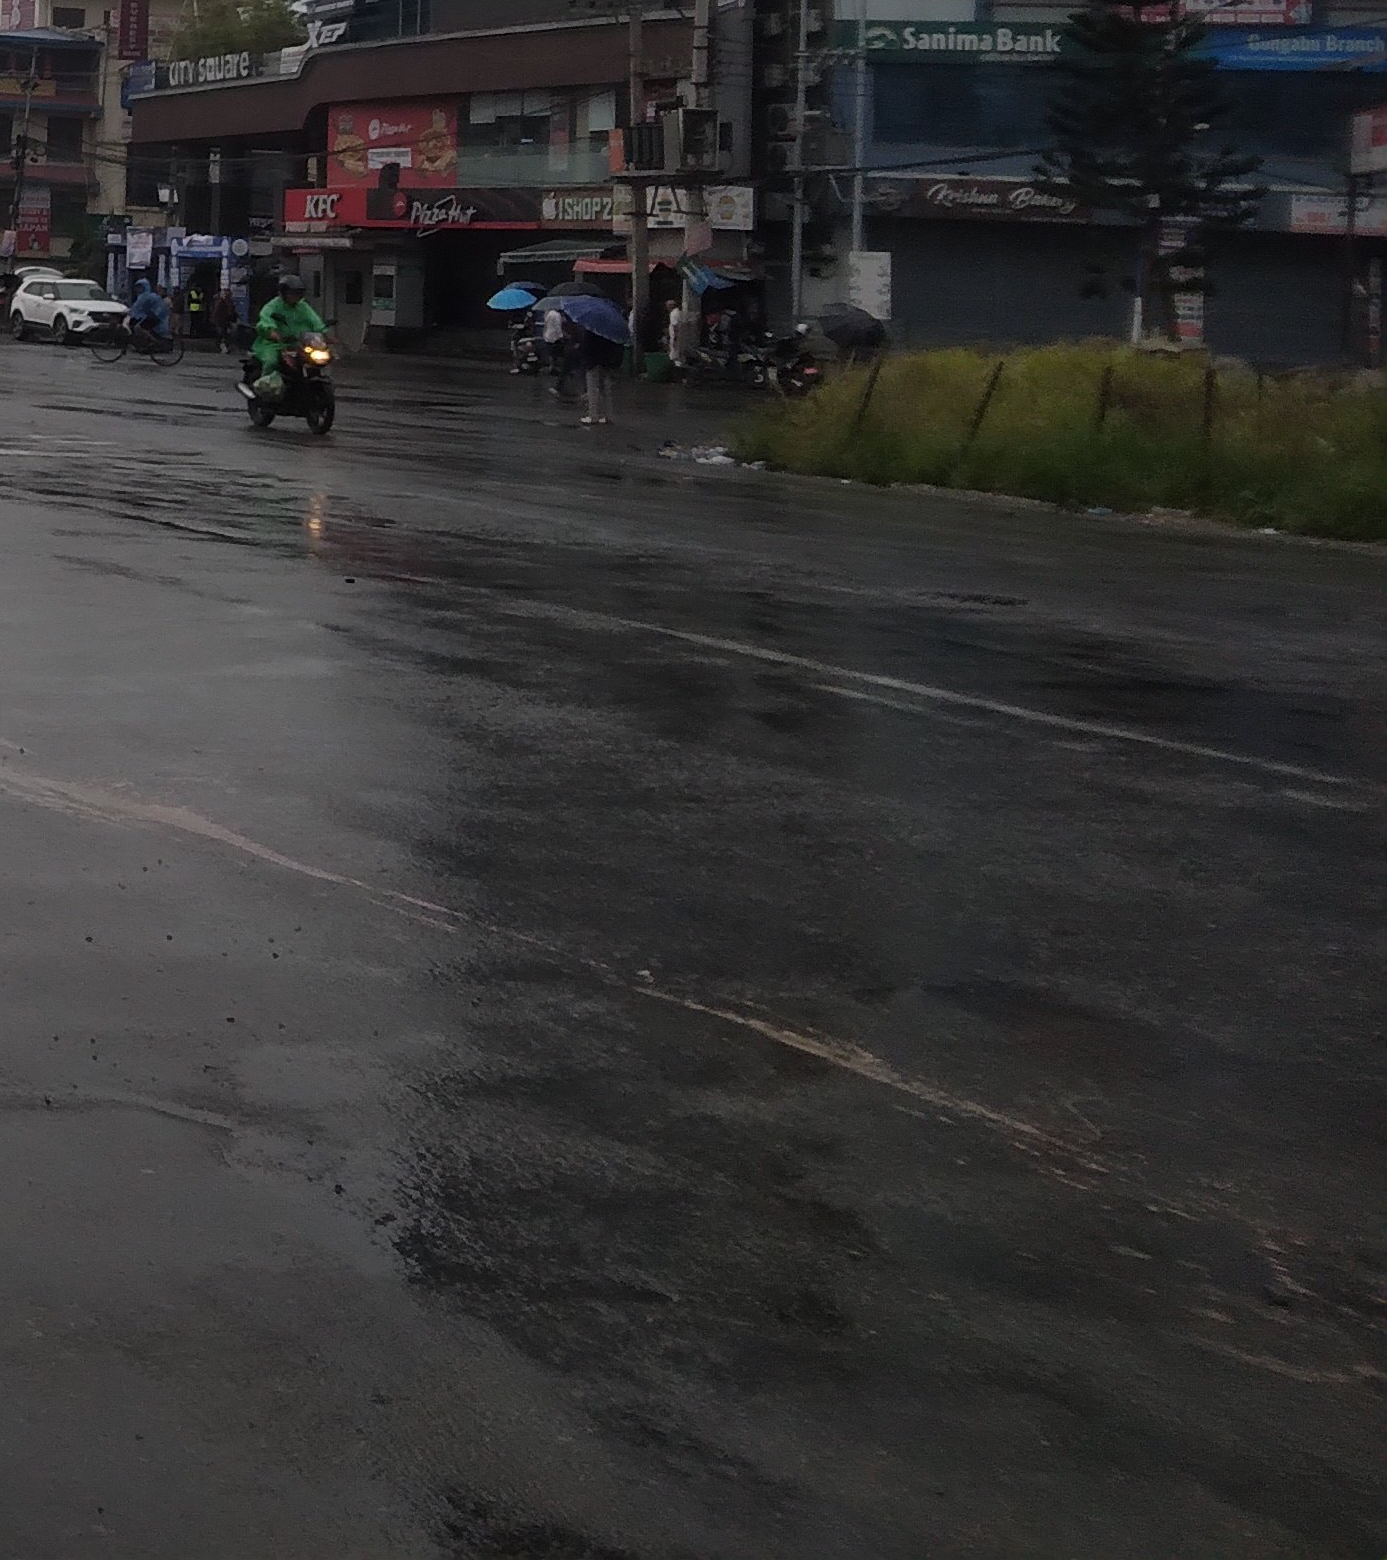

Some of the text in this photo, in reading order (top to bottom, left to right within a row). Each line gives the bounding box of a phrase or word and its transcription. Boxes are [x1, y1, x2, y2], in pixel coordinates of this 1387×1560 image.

[902, 27, 1063, 53] Sanima Bank
[169, 58, 195, 87] CITY
[304, 194, 341, 219] KFC
[410, 200, 477, 225] Pizza Hut
